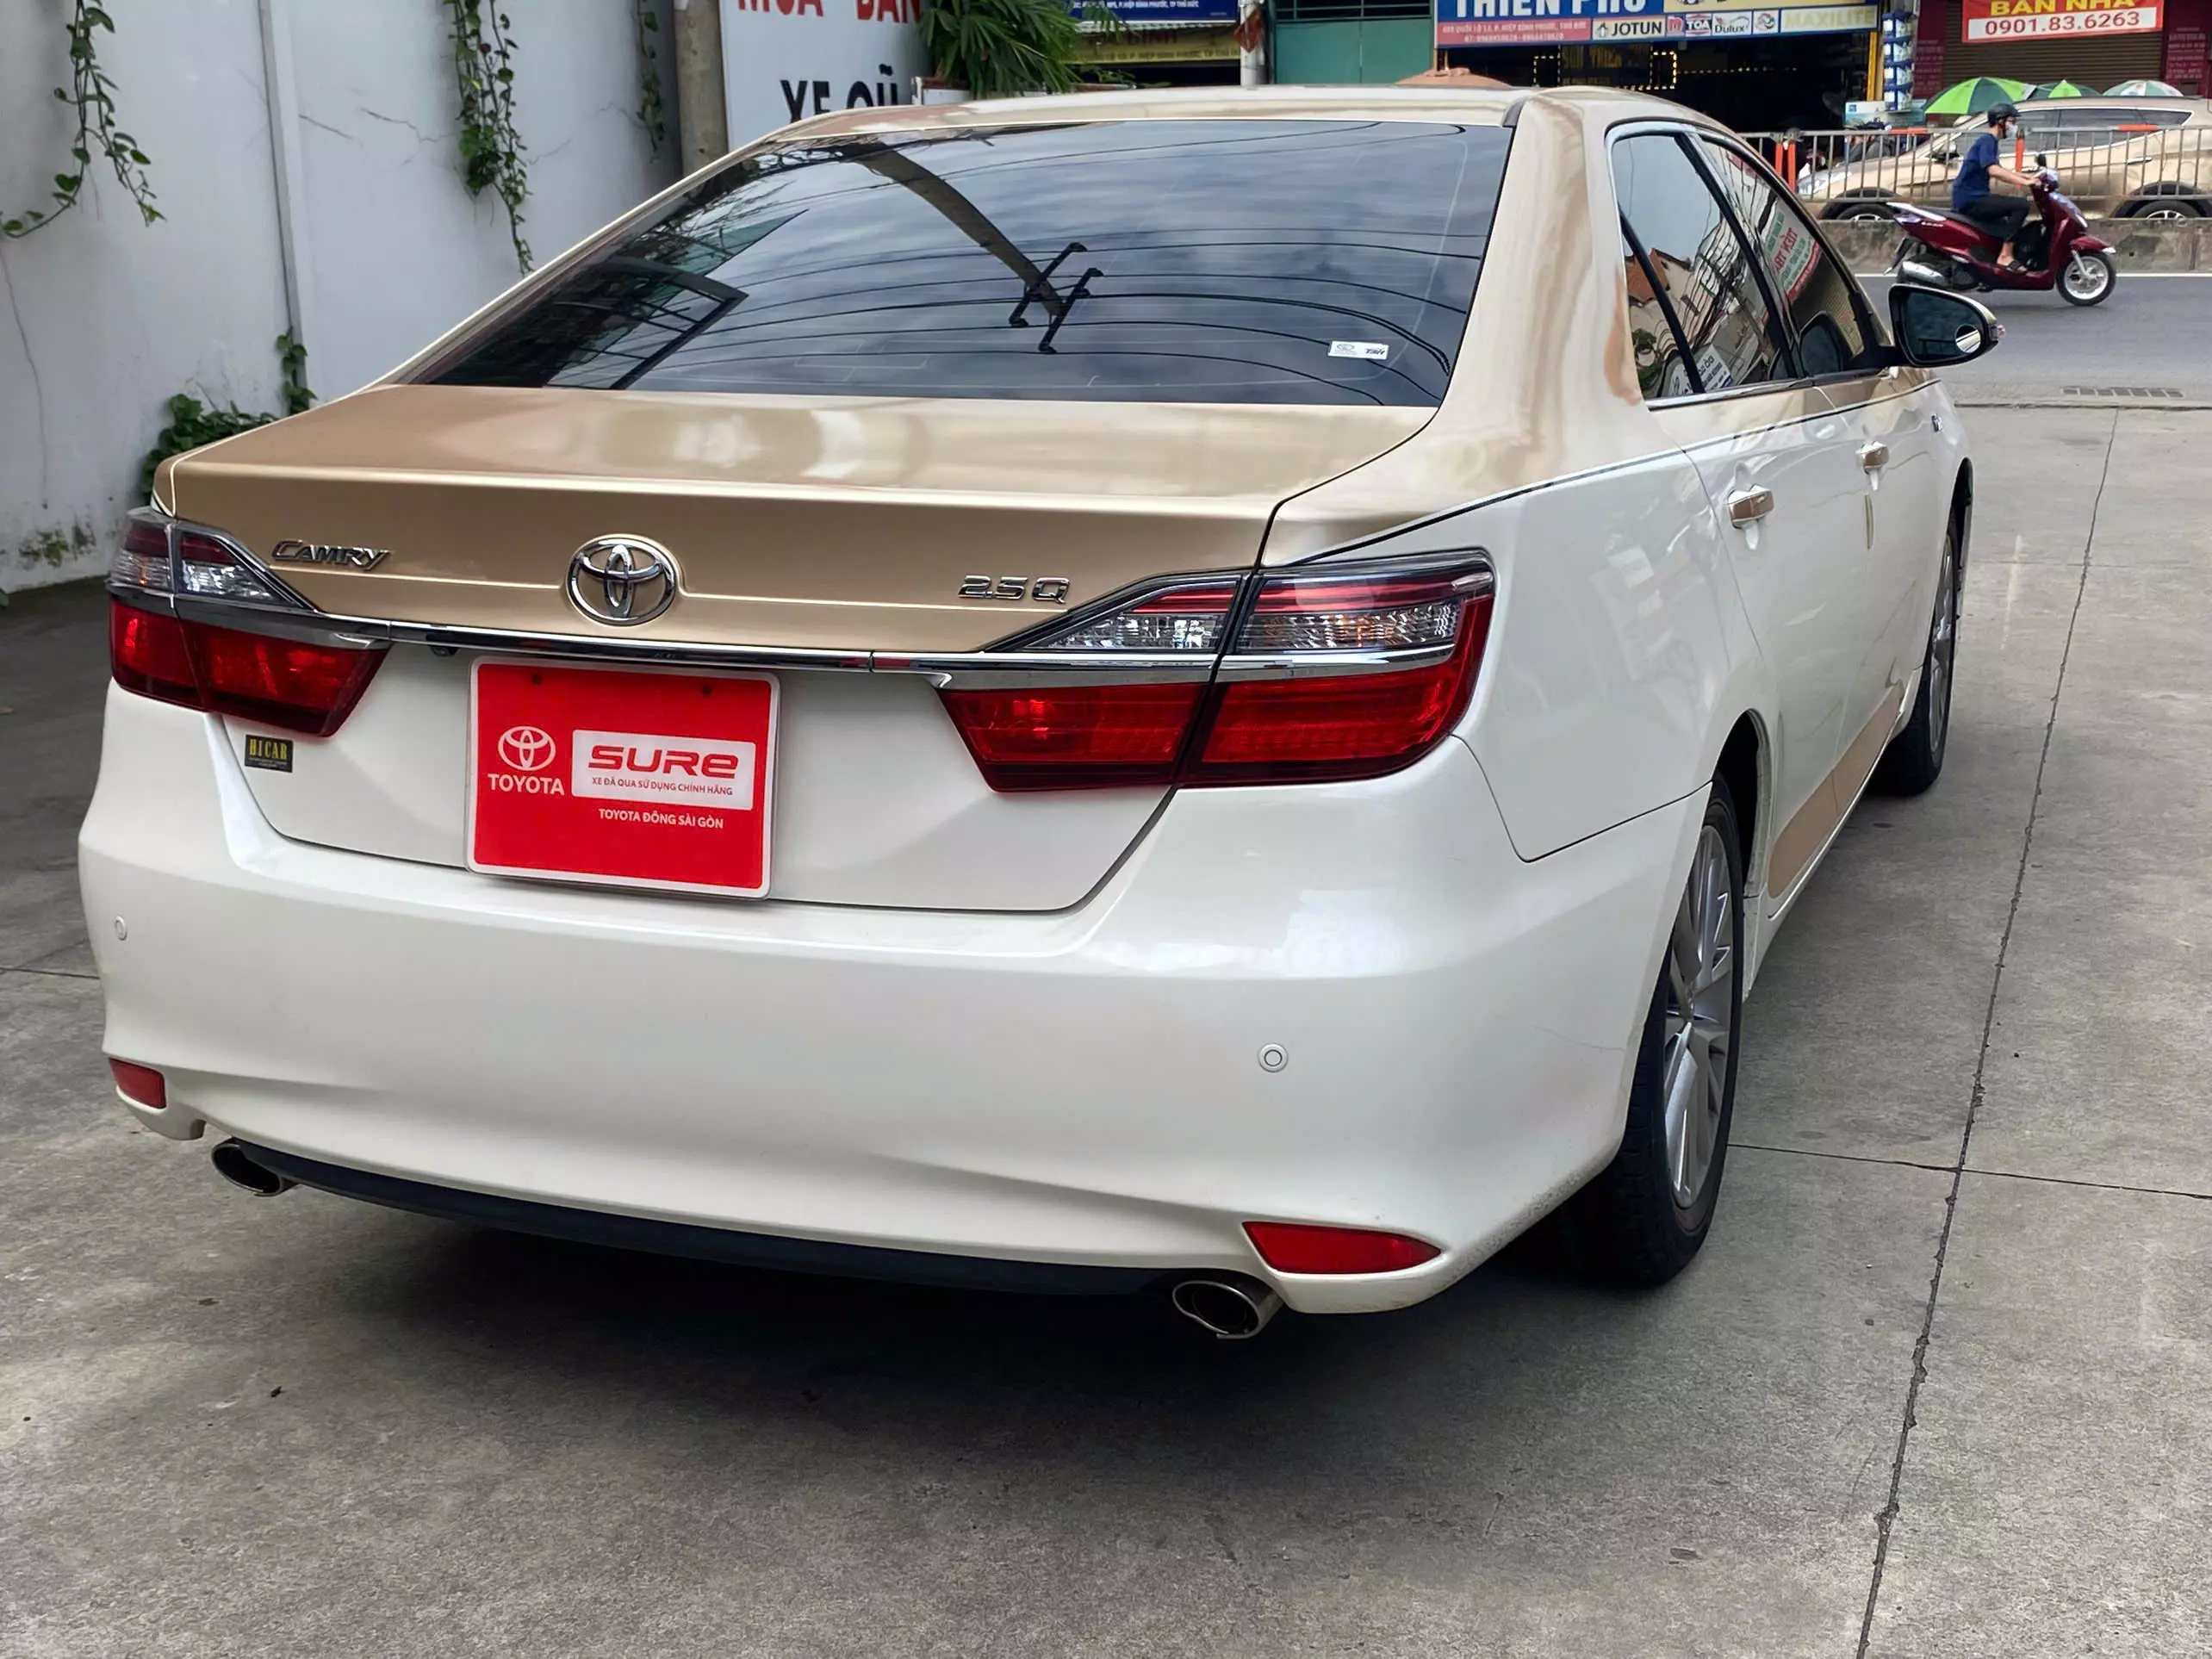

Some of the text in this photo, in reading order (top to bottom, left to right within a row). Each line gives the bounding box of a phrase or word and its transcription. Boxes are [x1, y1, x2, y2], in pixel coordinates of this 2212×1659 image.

[1687, 22, 1710, 30] TOA
[1786, 9, 1874, 28] MAXILITE
[1985, 11, 2140, 35] 0901.83.6263
[1612, 21, 1662, 36] JOTUN
[1714, 25, 1745, 34] Dulux
[271, 539, 391, 571] CAMRY
[488, 774, 565, 796] TOYOTA
[618, 779, 637, 787] QUA
[650, 781, 676, 792] DỤNG
[599, 808, 724, 829] TOYOTA ĐÔNG SÀI GÒN
